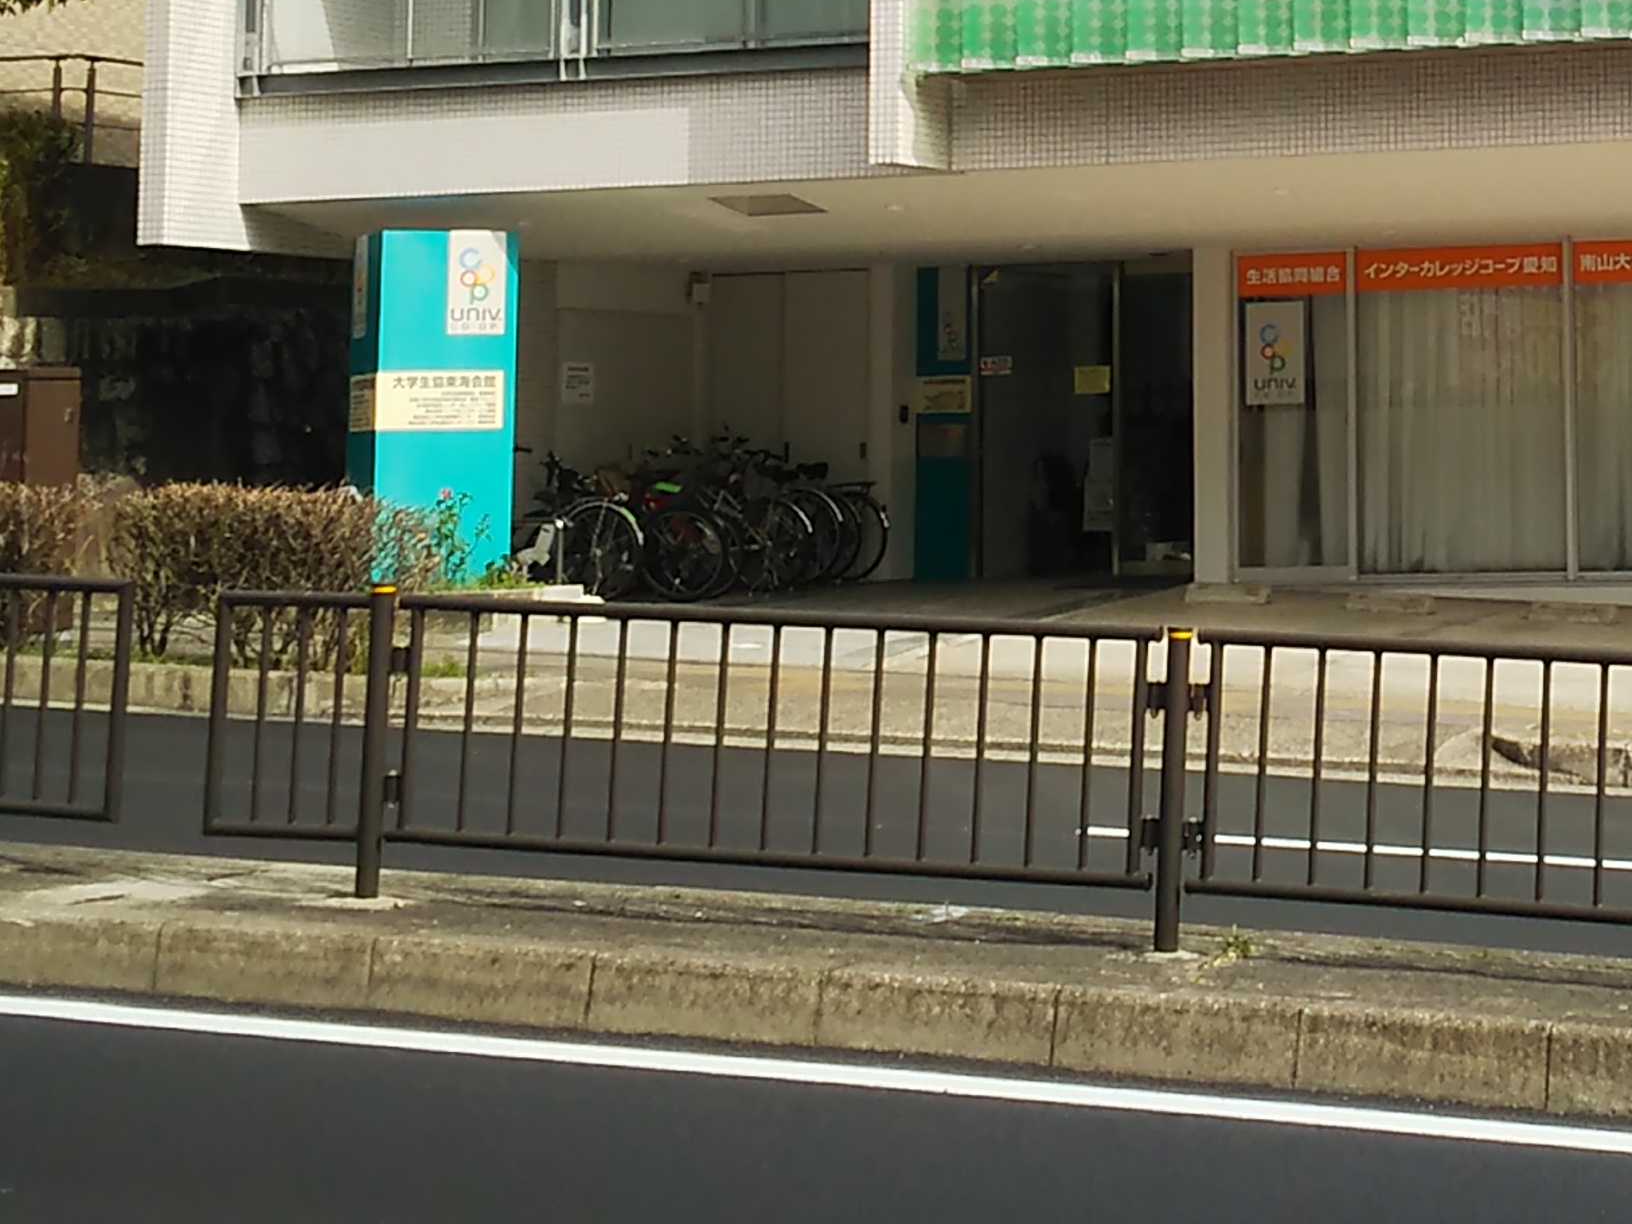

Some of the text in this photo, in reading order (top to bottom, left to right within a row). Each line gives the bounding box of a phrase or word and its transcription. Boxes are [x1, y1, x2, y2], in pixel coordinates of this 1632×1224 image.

[1246, 265, 1341, 285] 生活協同組合
